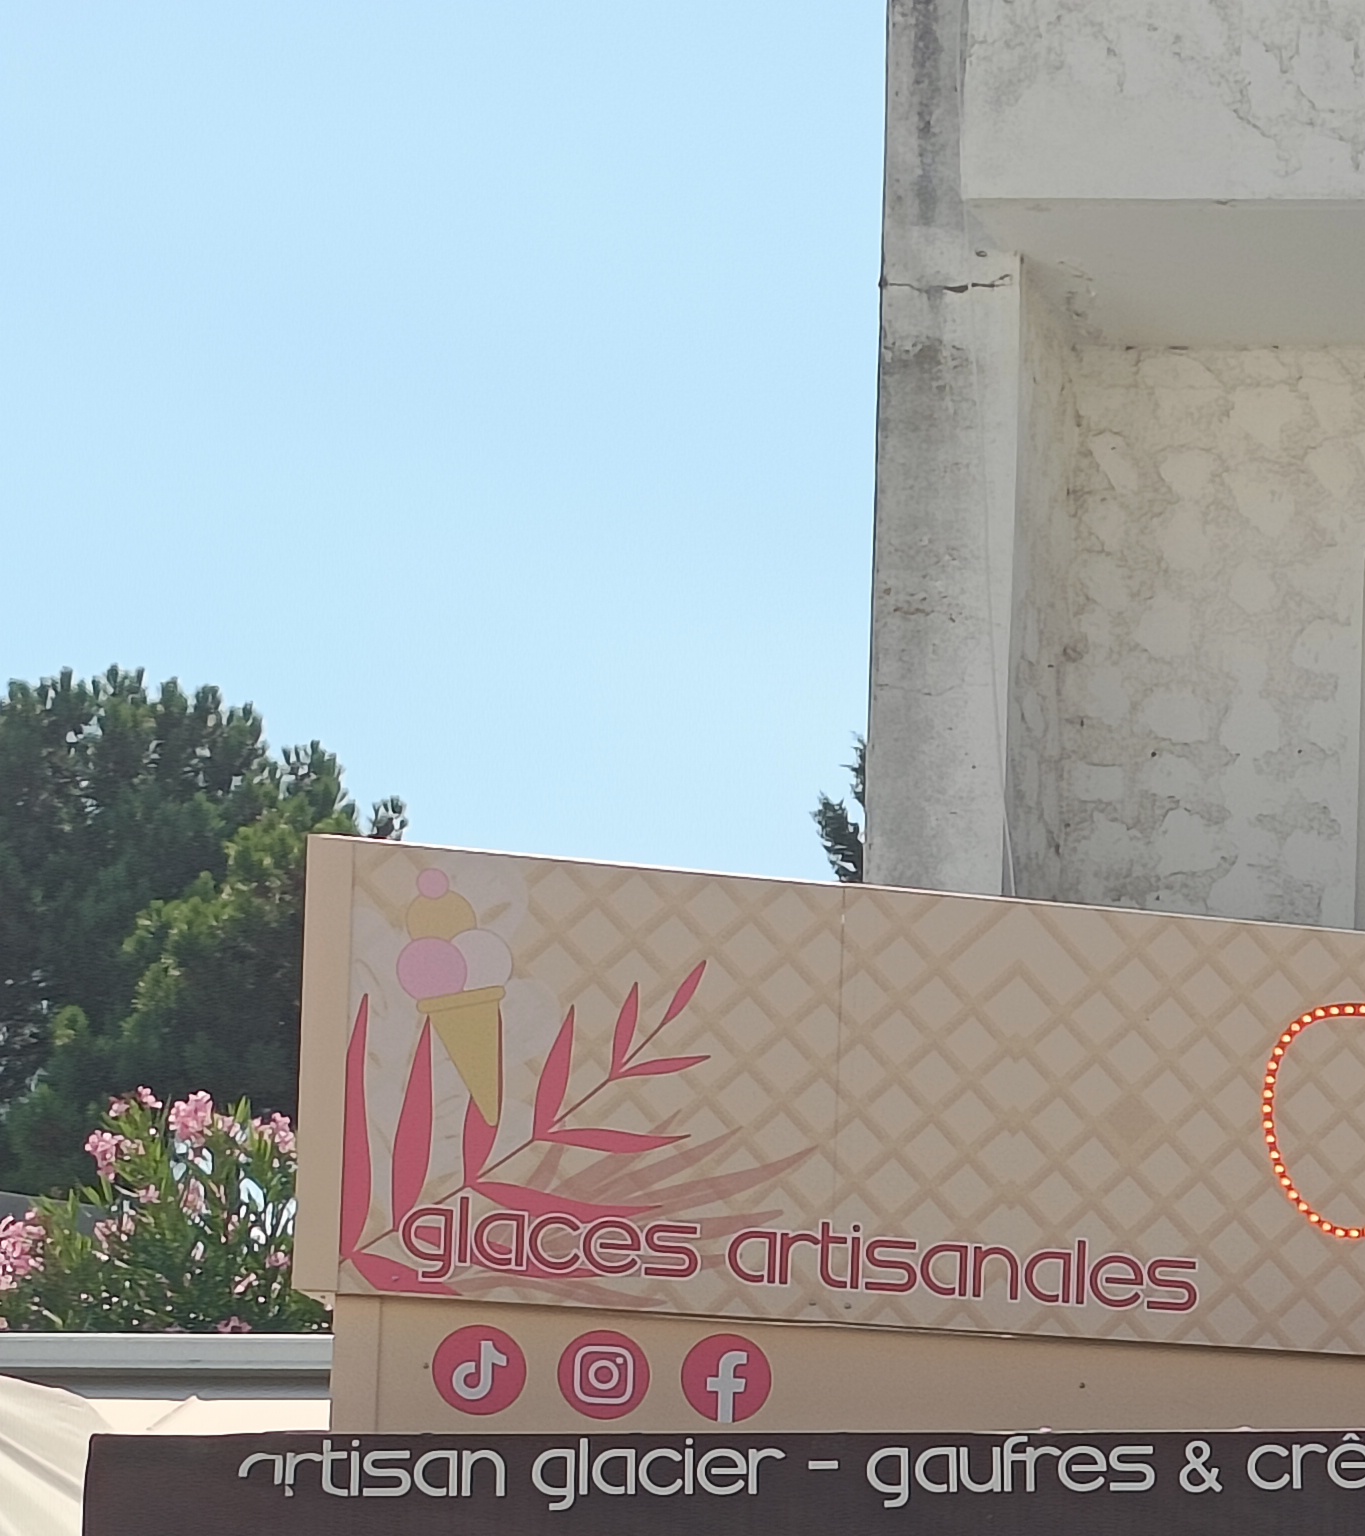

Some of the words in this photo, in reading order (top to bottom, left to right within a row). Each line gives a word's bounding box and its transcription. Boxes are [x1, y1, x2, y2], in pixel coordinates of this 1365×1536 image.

[402, 1198, 701, 1282] glaces
[726, 1222, 1199, 1313] artisanales
[531, 1438, 787, 1510] glacier
[865, 1436, 1157, 1507] gaufres
[1177, 1441, 1225, 1493] &
